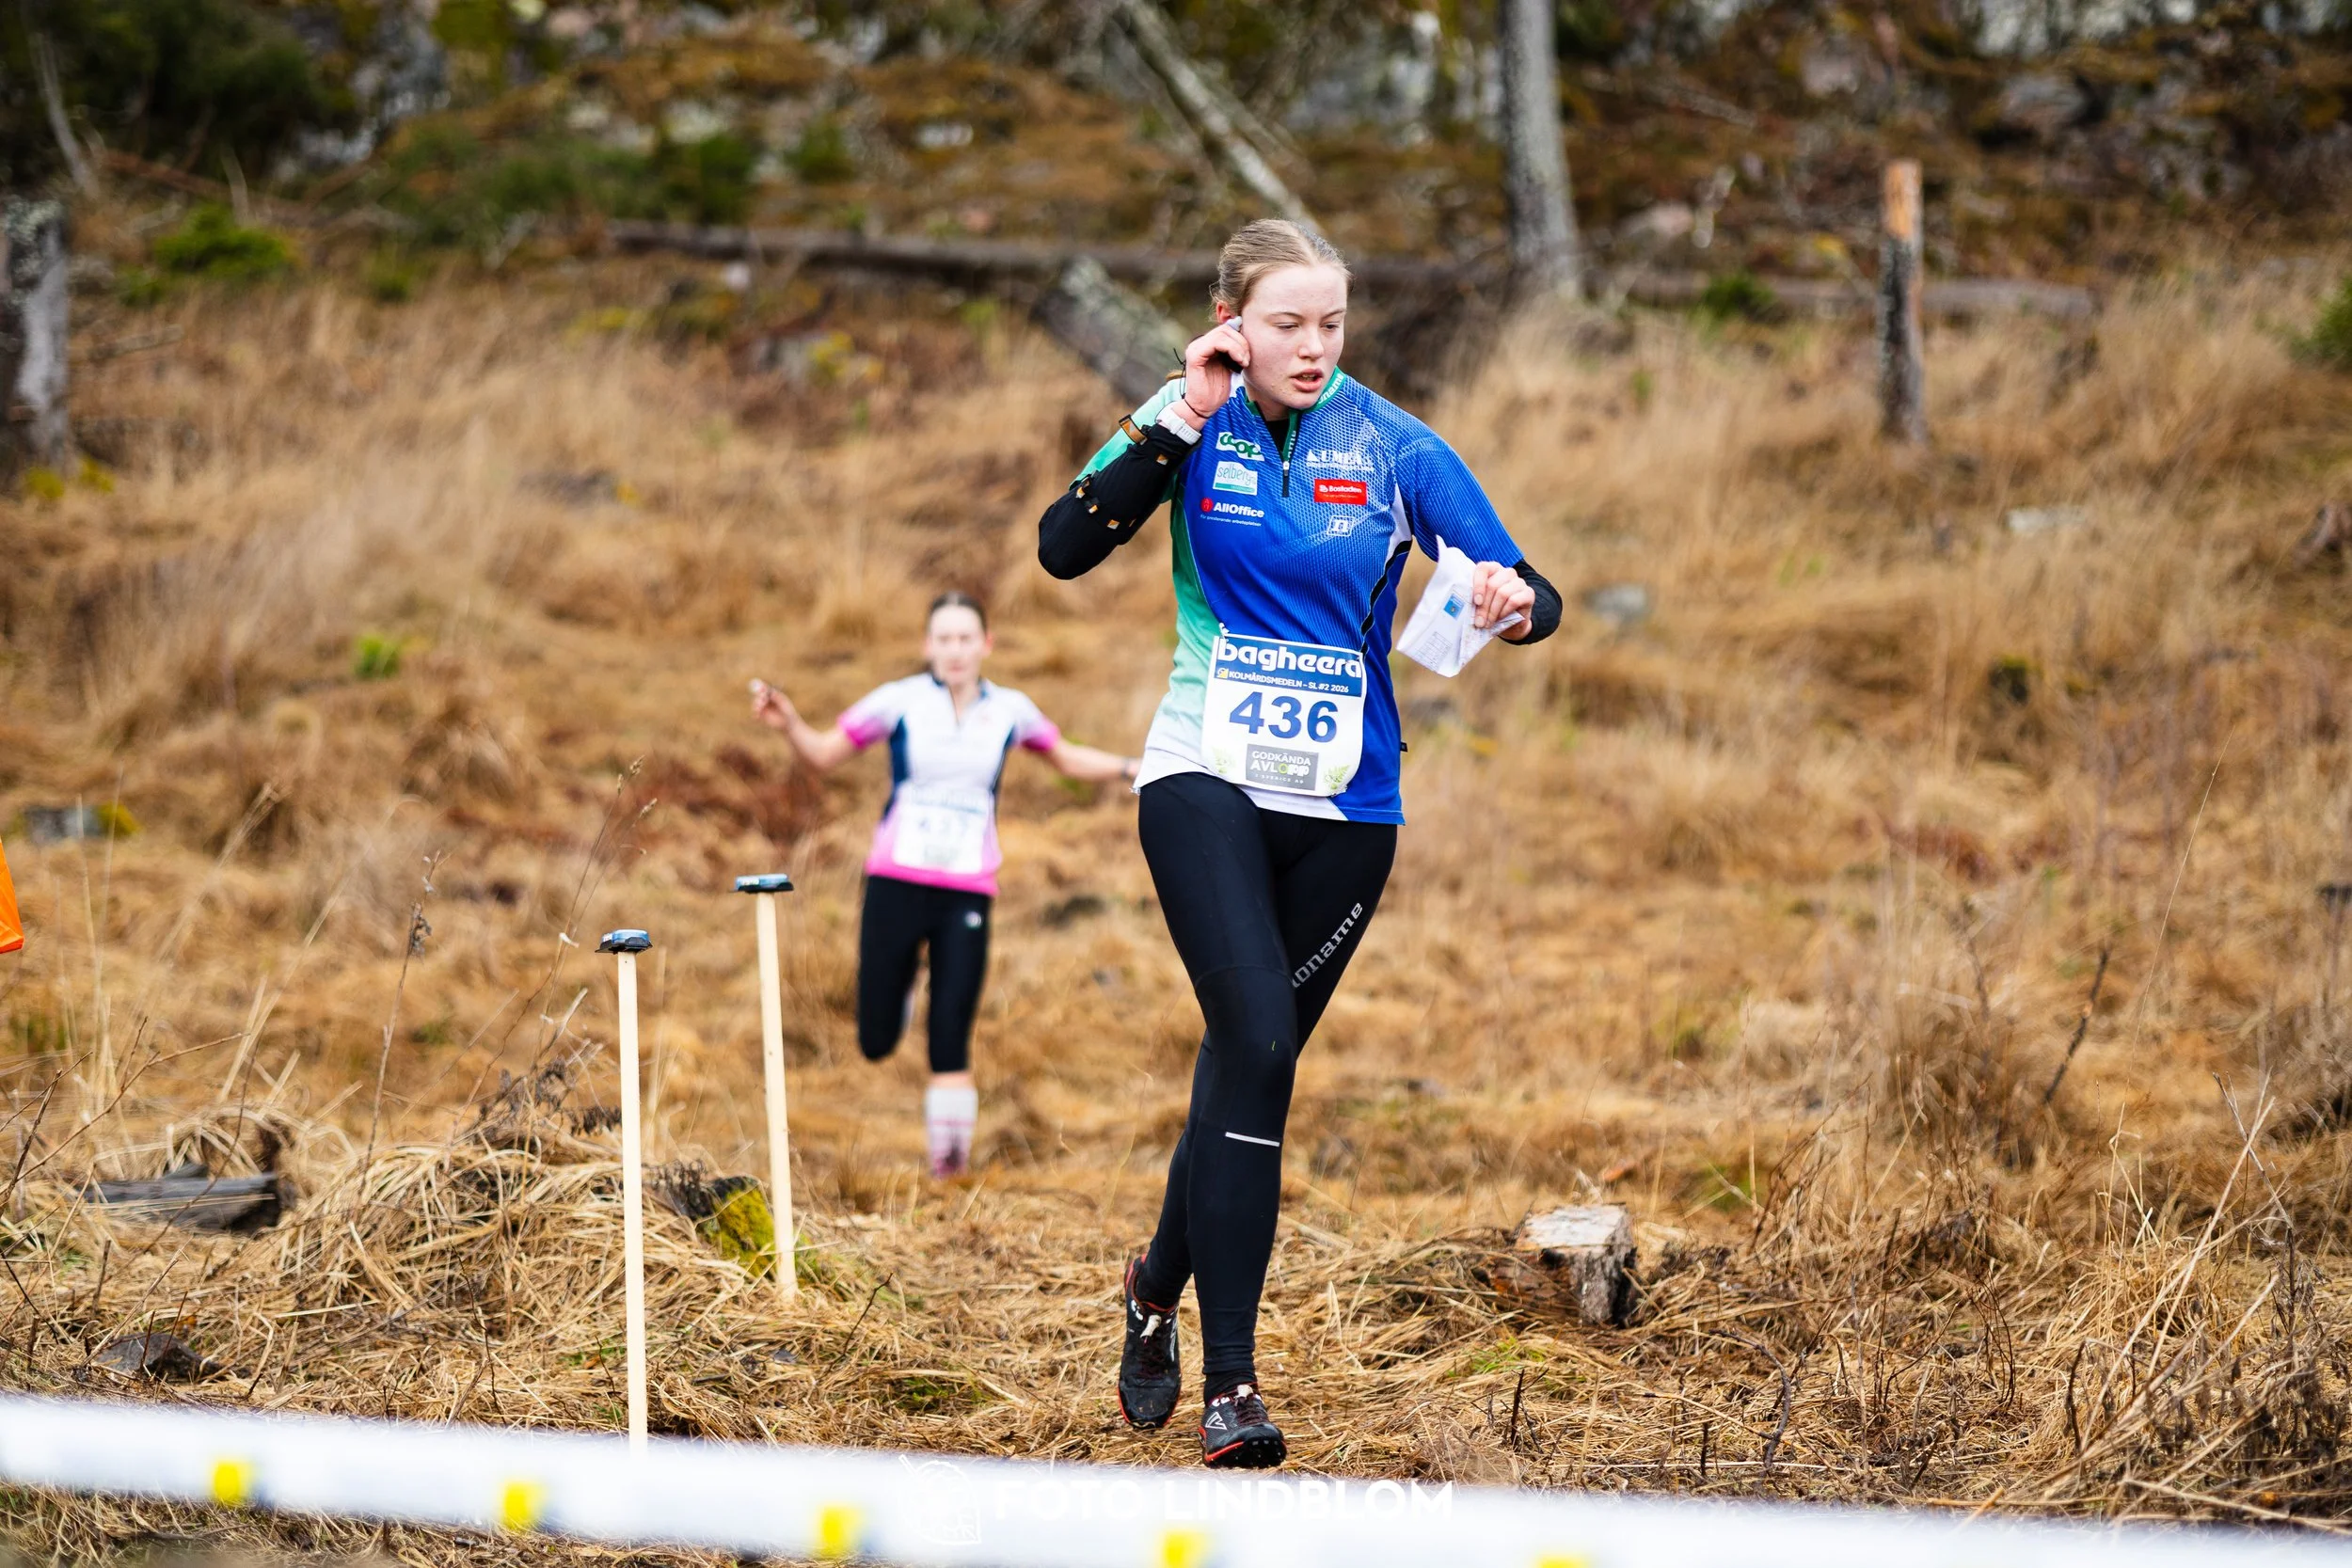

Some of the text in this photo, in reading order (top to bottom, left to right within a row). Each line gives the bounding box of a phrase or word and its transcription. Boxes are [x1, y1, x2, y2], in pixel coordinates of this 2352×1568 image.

[1219, 433, 1263, 458] coop
[1214, 501, 1264, 519] AllOffice
[1217, 638, 1363, 678] bagheera
[1228, 670, 1303, 688] KOLMÅRDSMEDELN
[1308, 681, 1318, 690] SL
[1330, 684, 1349, 694] 2026
[1229, 690, 1339, 743] 436
[1251, 751, 1311, 766] GODKÄNDA
